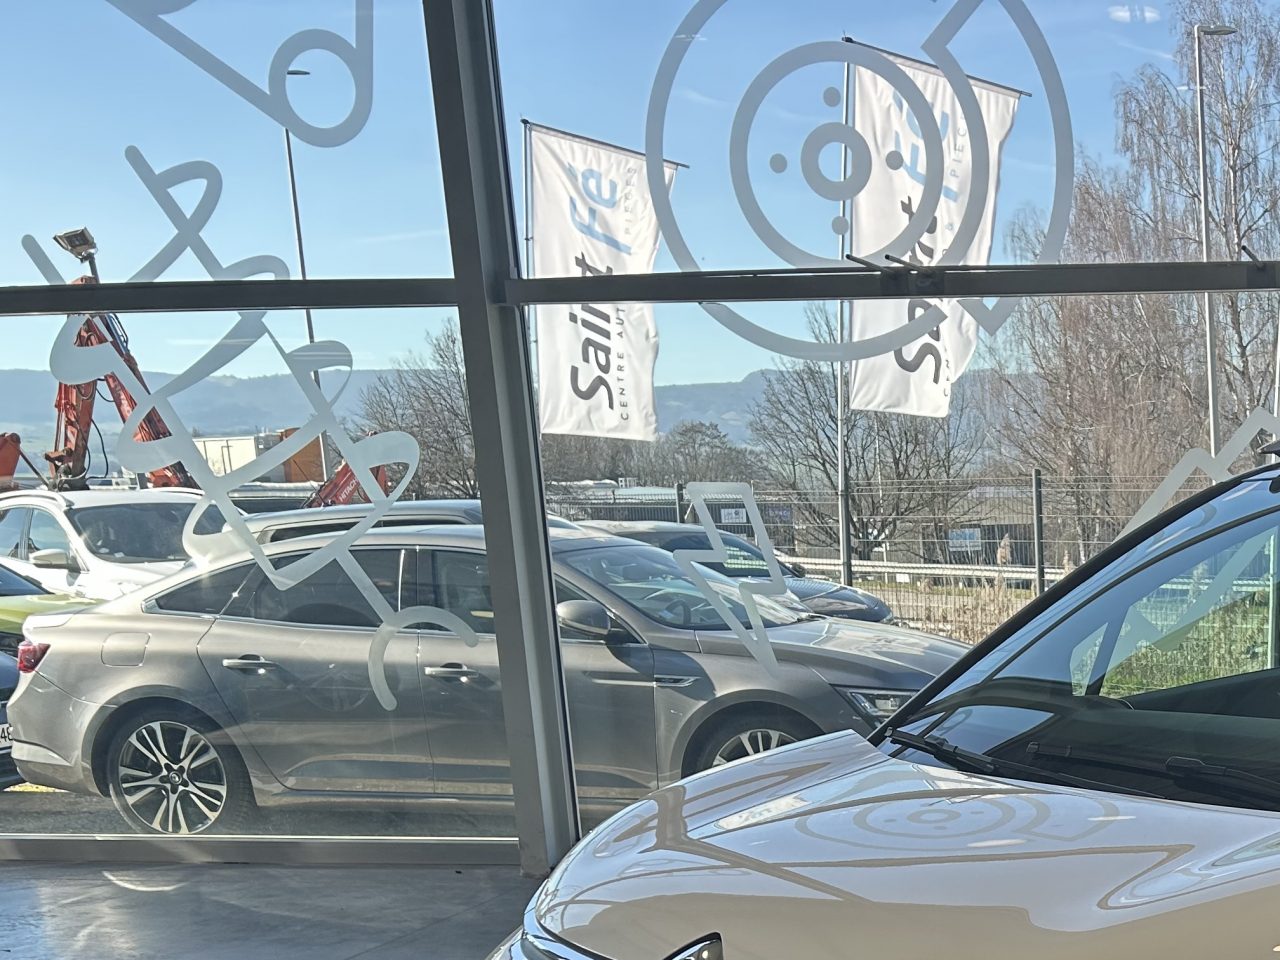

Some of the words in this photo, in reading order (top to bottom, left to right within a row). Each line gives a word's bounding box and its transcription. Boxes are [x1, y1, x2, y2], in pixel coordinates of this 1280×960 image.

[567, 161, 632, 256] Fé
[616, 306, 626, 338] AUT
[617, 352, 629, 421] CENTRE
